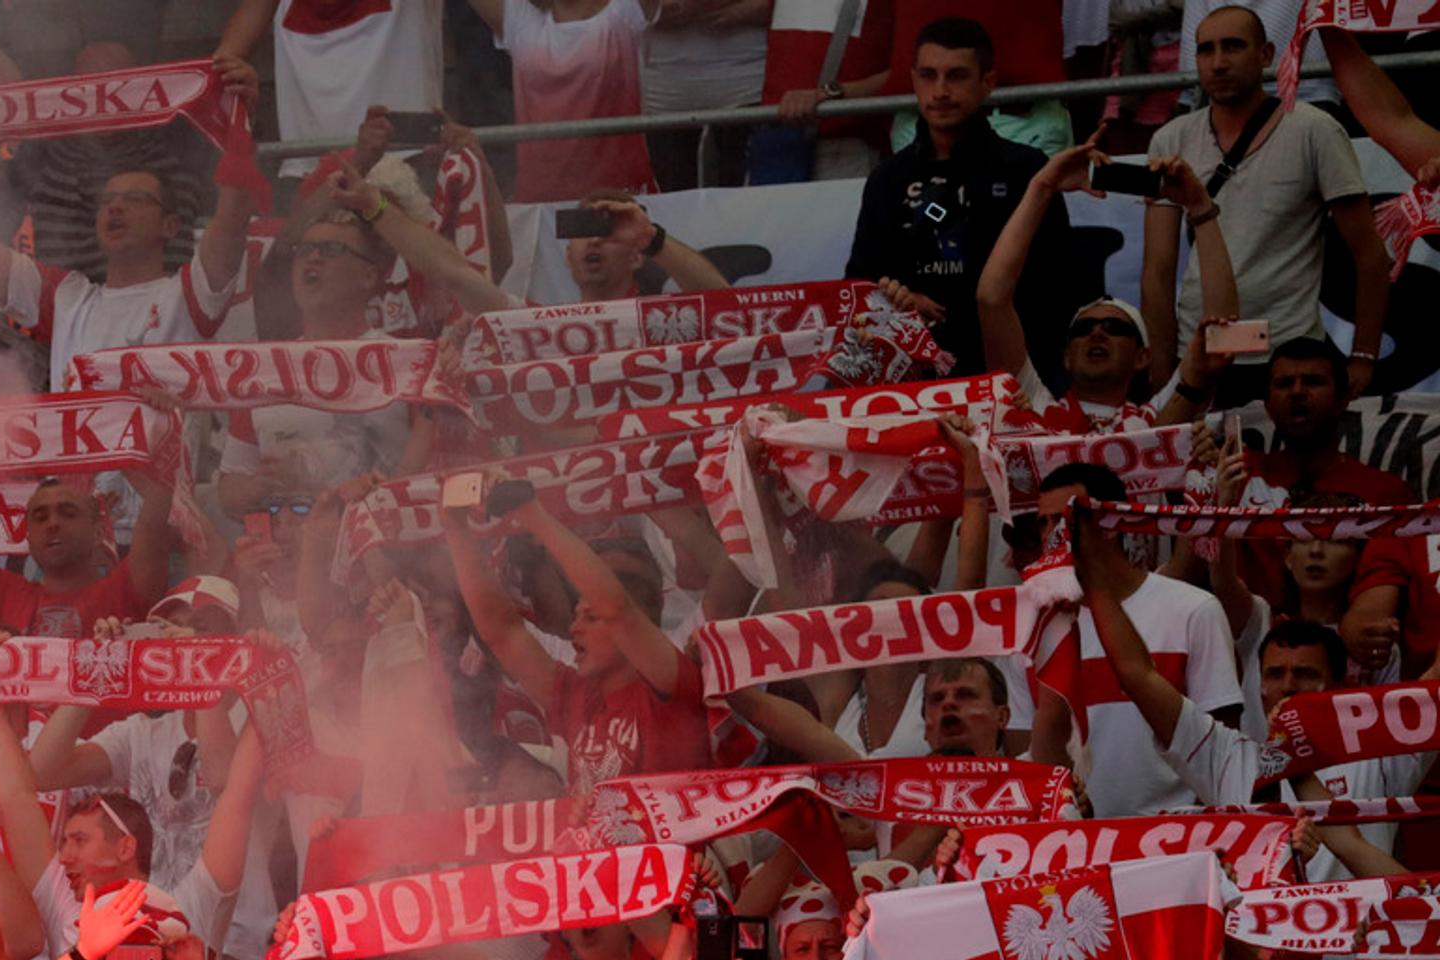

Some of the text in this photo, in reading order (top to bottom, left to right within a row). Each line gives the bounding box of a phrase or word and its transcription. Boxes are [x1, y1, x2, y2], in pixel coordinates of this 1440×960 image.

[532, 288, 806, 320] ZAWSZE WIERNI
[466, 332, 800, 430] POLSKA
[1277, 708, 1315, 759] BIAŁO
[924, 760, 1010, 774] WIERNI
[638, 780, 672, 842] TYLKO
[891, 777, 1034, 814] SKA
[894, 810, 1031, 828] CZERWONYM
[321, 846, 674, 956] POLSKA
[1271, 883, 1350, 900] ZAWSZE
